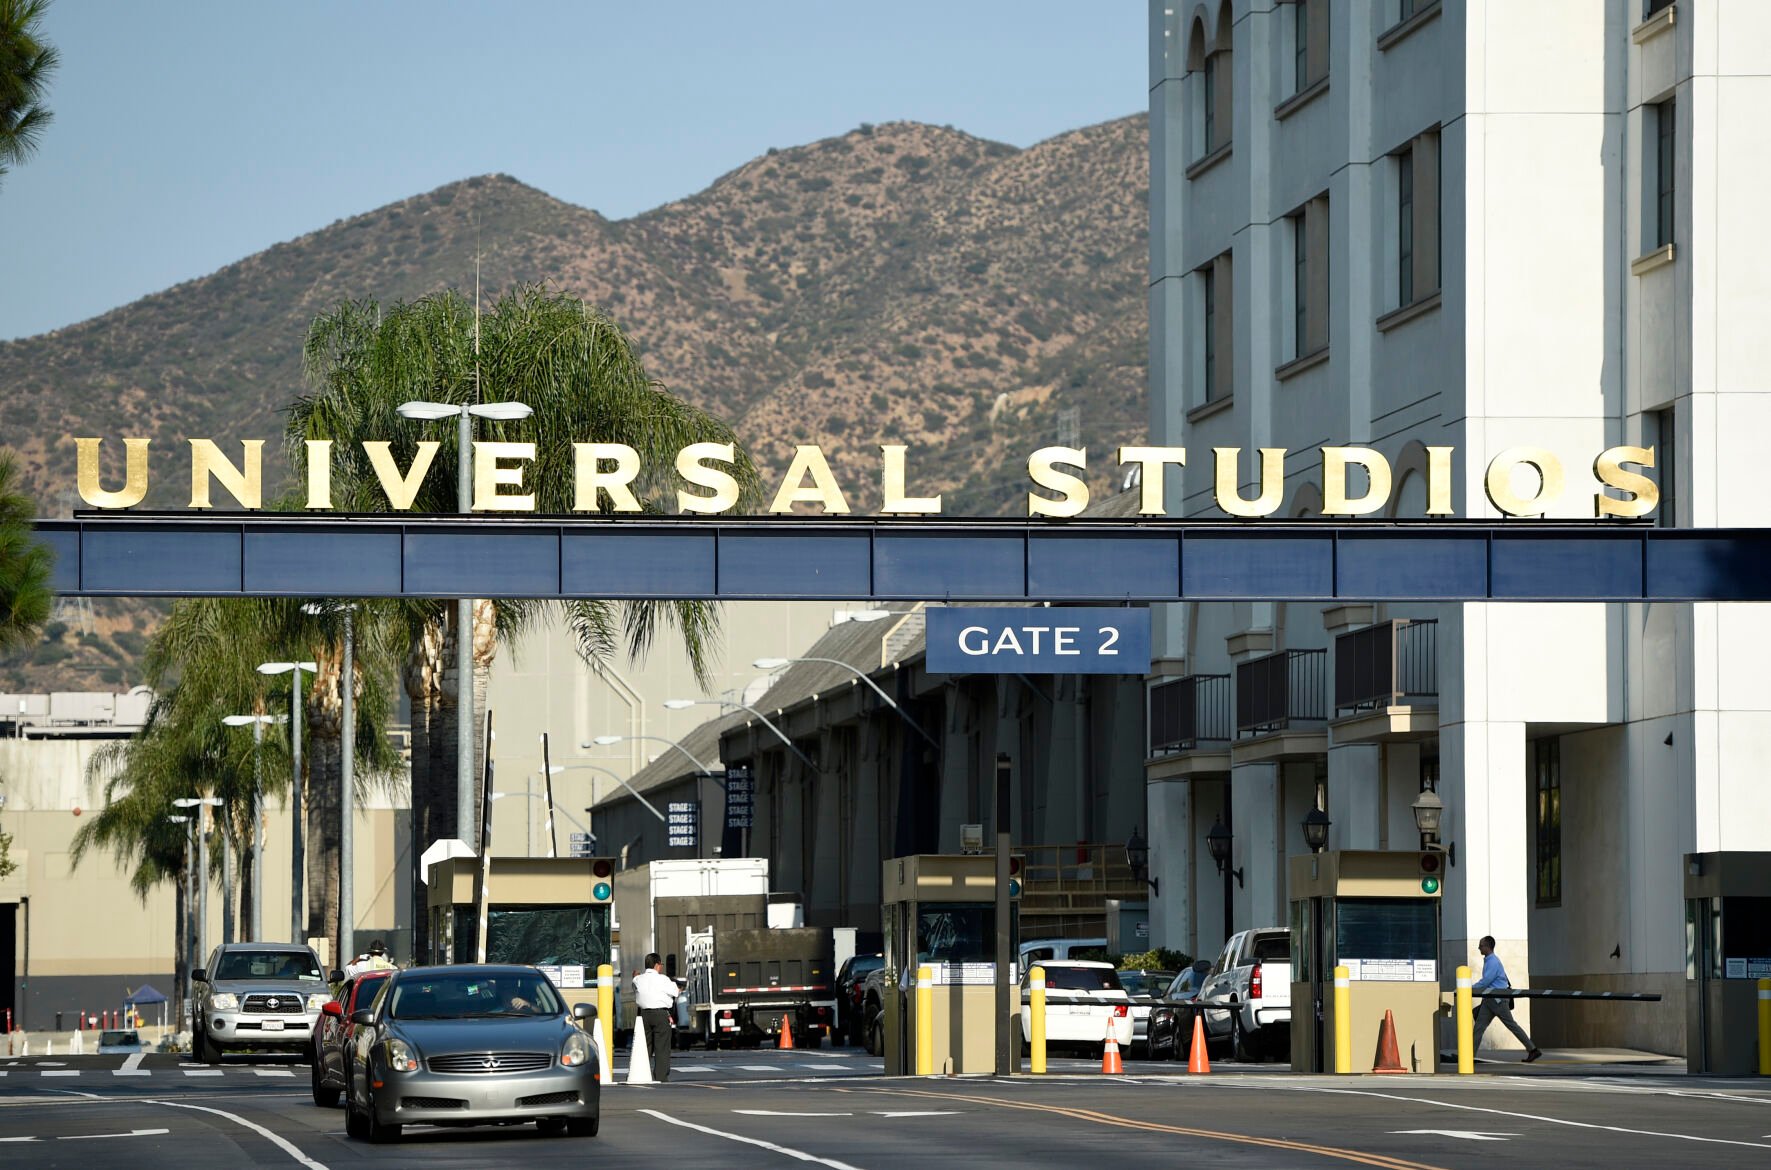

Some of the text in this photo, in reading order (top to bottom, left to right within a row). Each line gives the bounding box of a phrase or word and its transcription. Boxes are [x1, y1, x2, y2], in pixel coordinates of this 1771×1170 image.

[73, 437, 1660, 518] UNIVERSAL STUDIOS
[958, 626, 1120, 656] GATE 2
[668, 803, 688, 812] STAGE
[668, 814, 688, 824] STAGE
[669, 826, 688, 835] STAGE
[669, 837, 688, 847] STAGE
